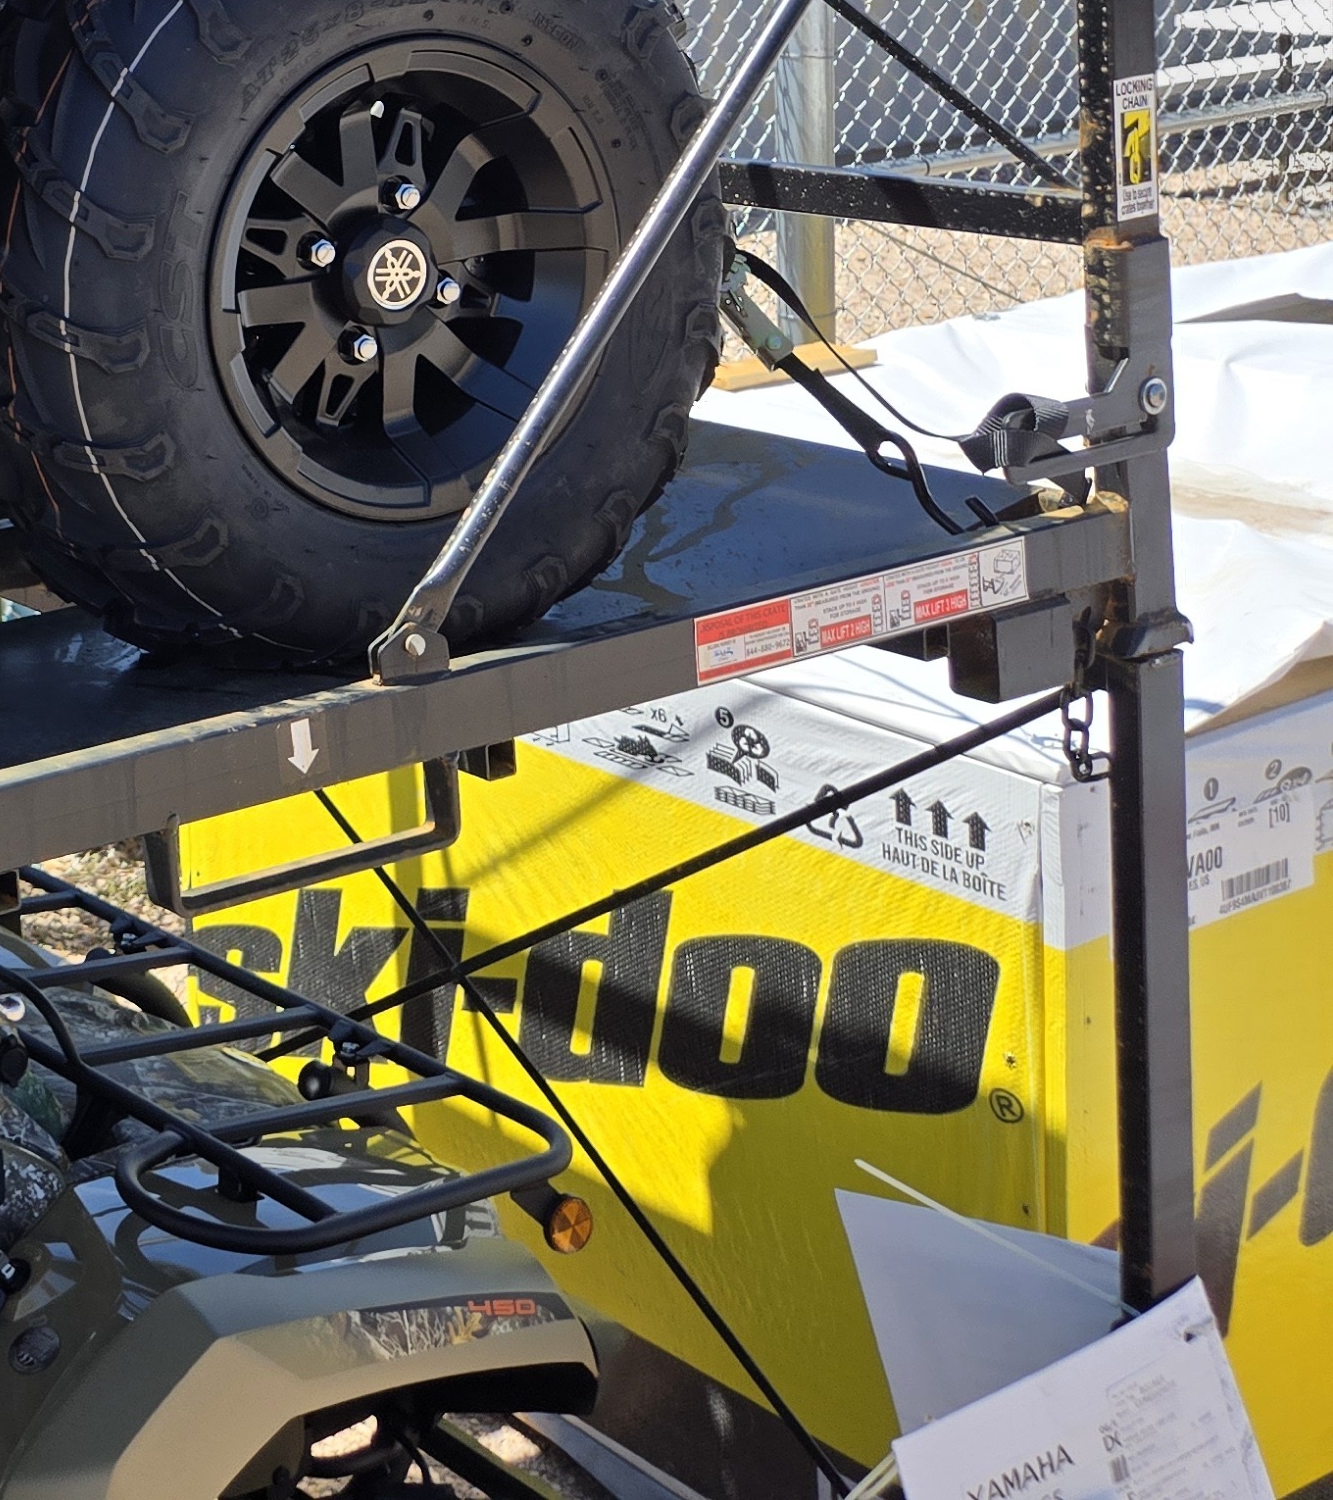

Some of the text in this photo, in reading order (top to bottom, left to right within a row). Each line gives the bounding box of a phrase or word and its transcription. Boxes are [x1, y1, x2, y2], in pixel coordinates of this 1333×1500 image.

[1115, 77, 1154, 97] LOCKING
[1122, 94, 1148, 110] CHAIN
[895, 826, 985, 871] THIS SIDE UP
[882, 841, 1008, 902] HAUT DE LA BOÎTE
[189, 886, 1002, 1115] ski-doo
[467, 1298, 536, 1317] 450
